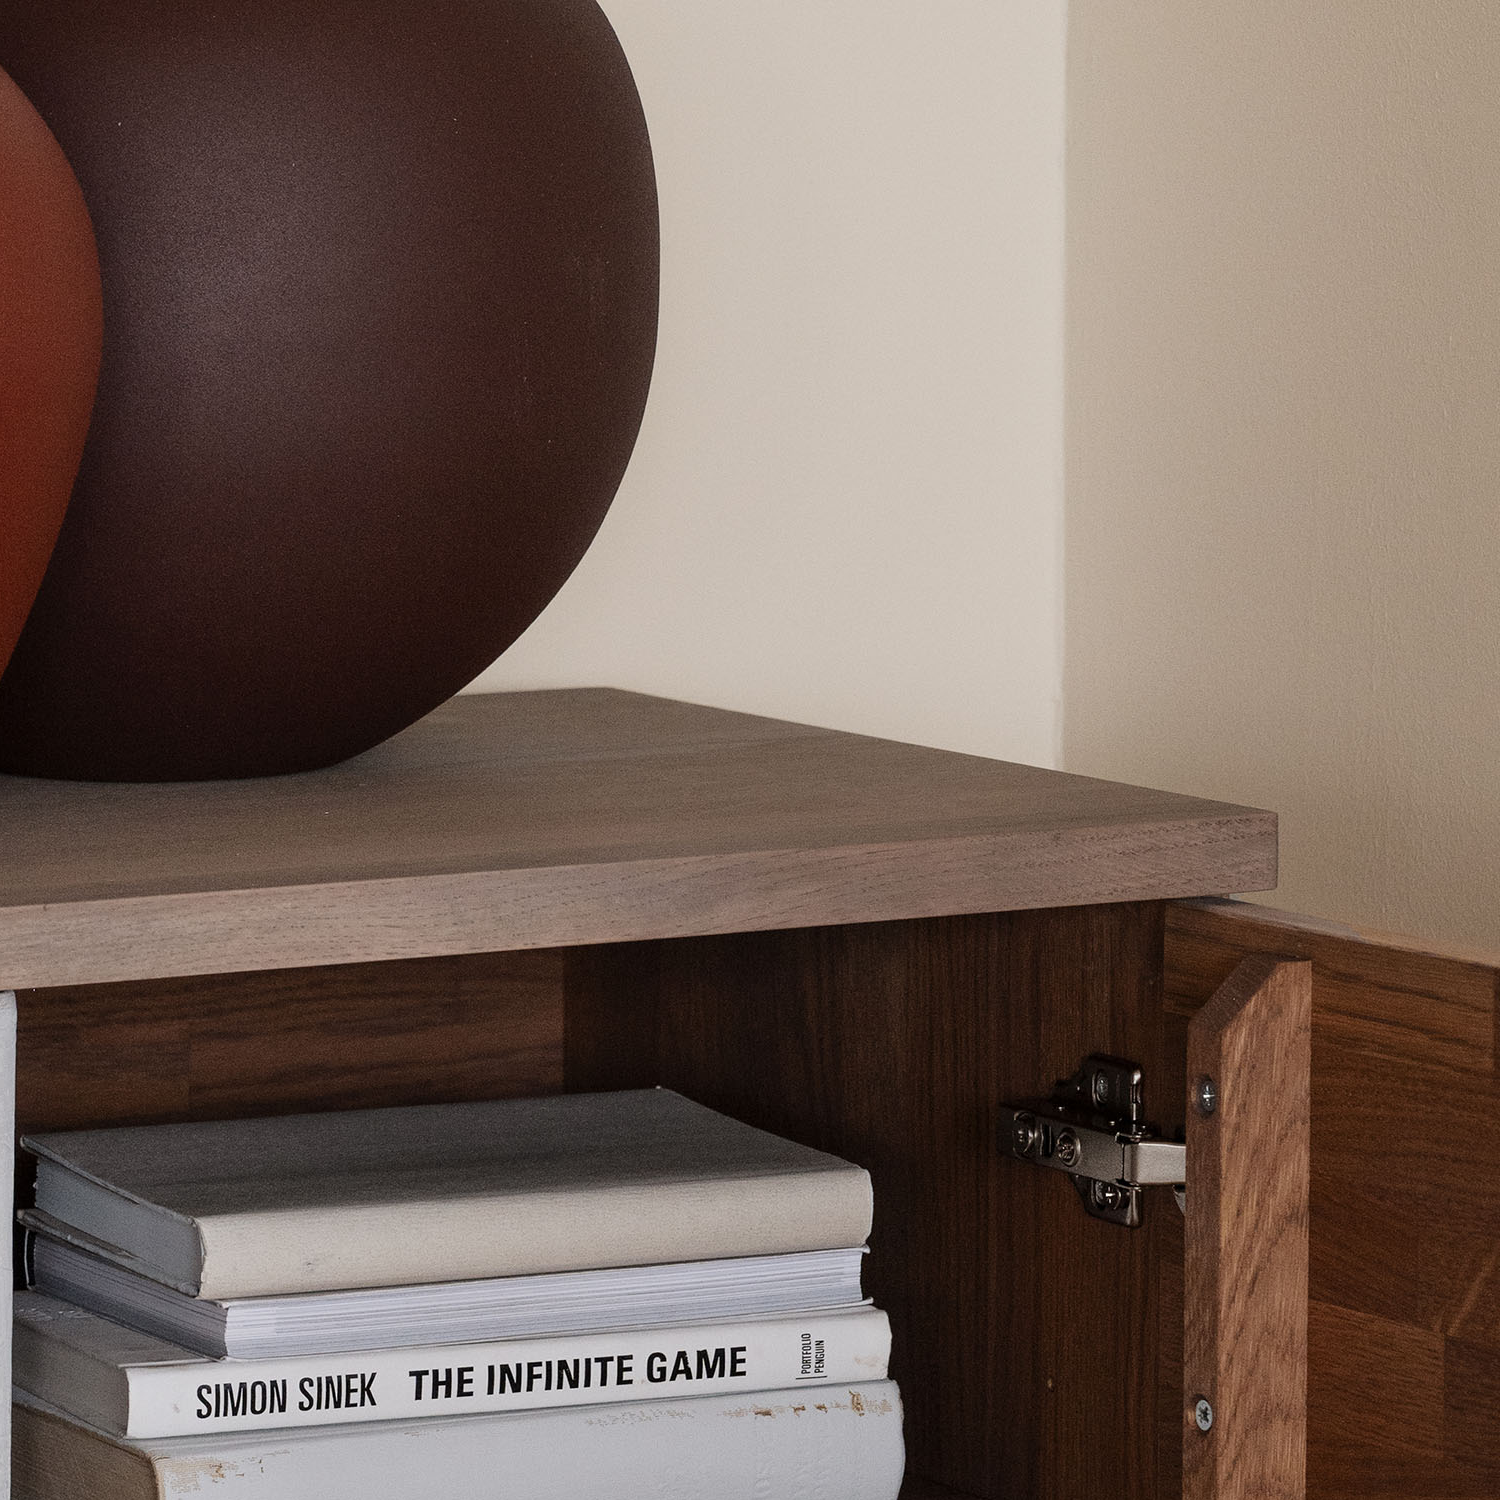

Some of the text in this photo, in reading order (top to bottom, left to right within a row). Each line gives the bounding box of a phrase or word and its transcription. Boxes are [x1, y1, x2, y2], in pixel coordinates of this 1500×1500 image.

[800, 1333, 812, 1375] PORTFOLIO
[814, 1340, 825, 1374] PENGUIN
[196, 1346, 748, 1419] SIMON SINEK THE INFINITE GAME
